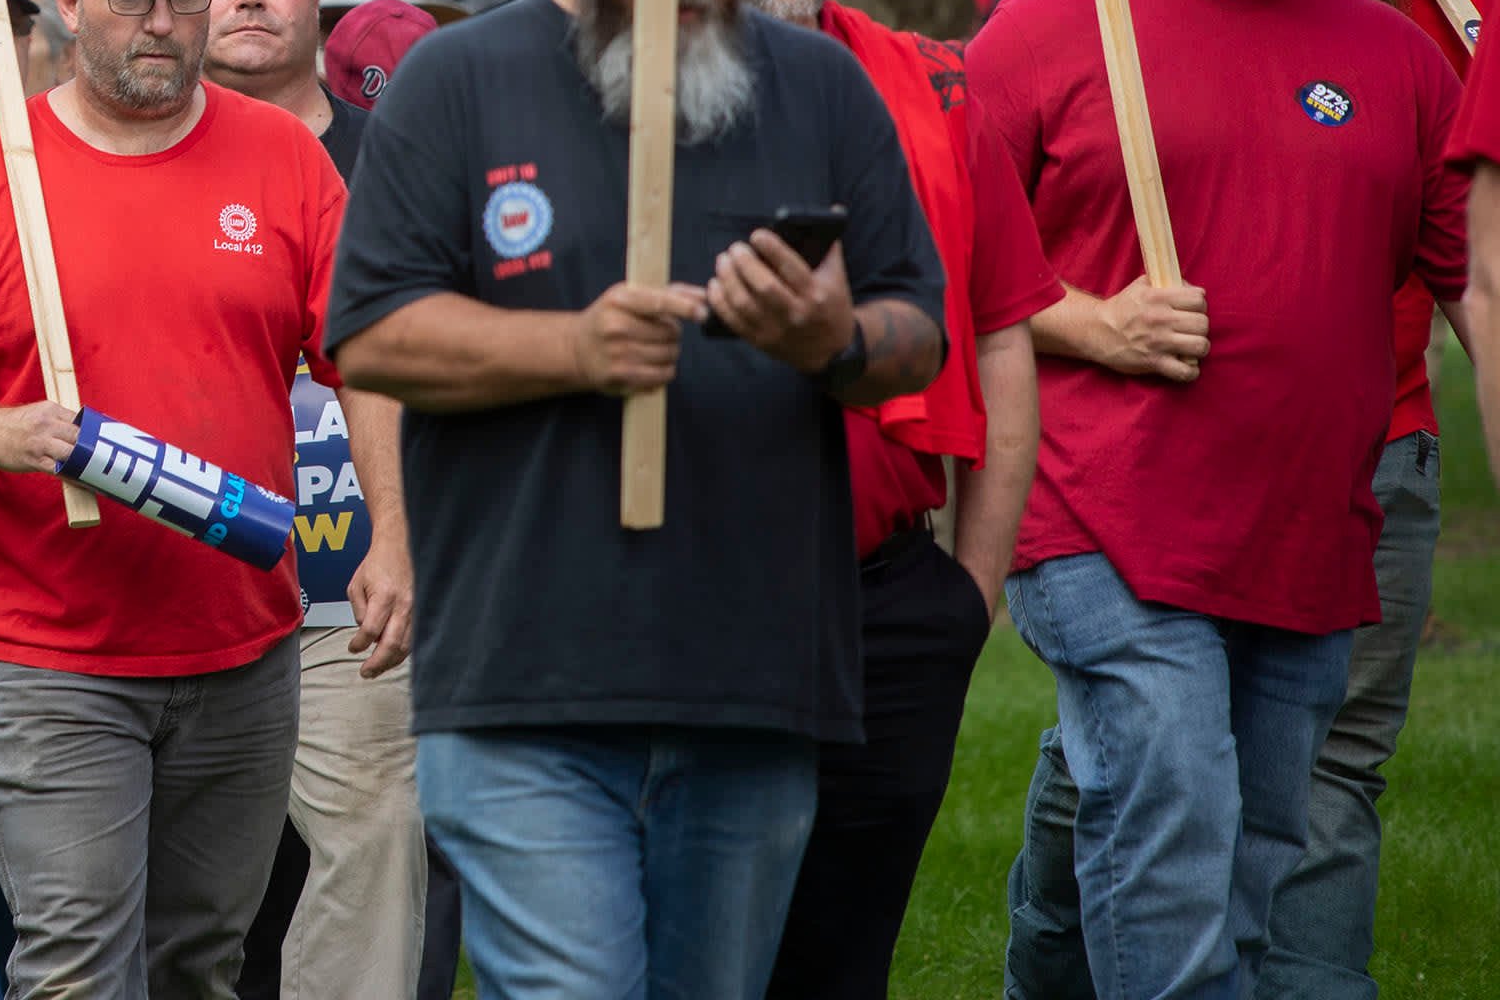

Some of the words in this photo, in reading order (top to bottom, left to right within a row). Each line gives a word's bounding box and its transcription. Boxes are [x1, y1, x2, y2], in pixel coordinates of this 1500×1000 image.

[362, 65, 387, 98] D
[1306, 97, 1343, 121] STRIKE
[1309, 92, 1335, 109] READY
[1334, 106, 1345, 116] TO
[1313, 83, 1350, 111] 97%
[214, 239, 242, 252] Local
[244, 243, 263, 255] 412
[298, 462, 364, 506] PA
